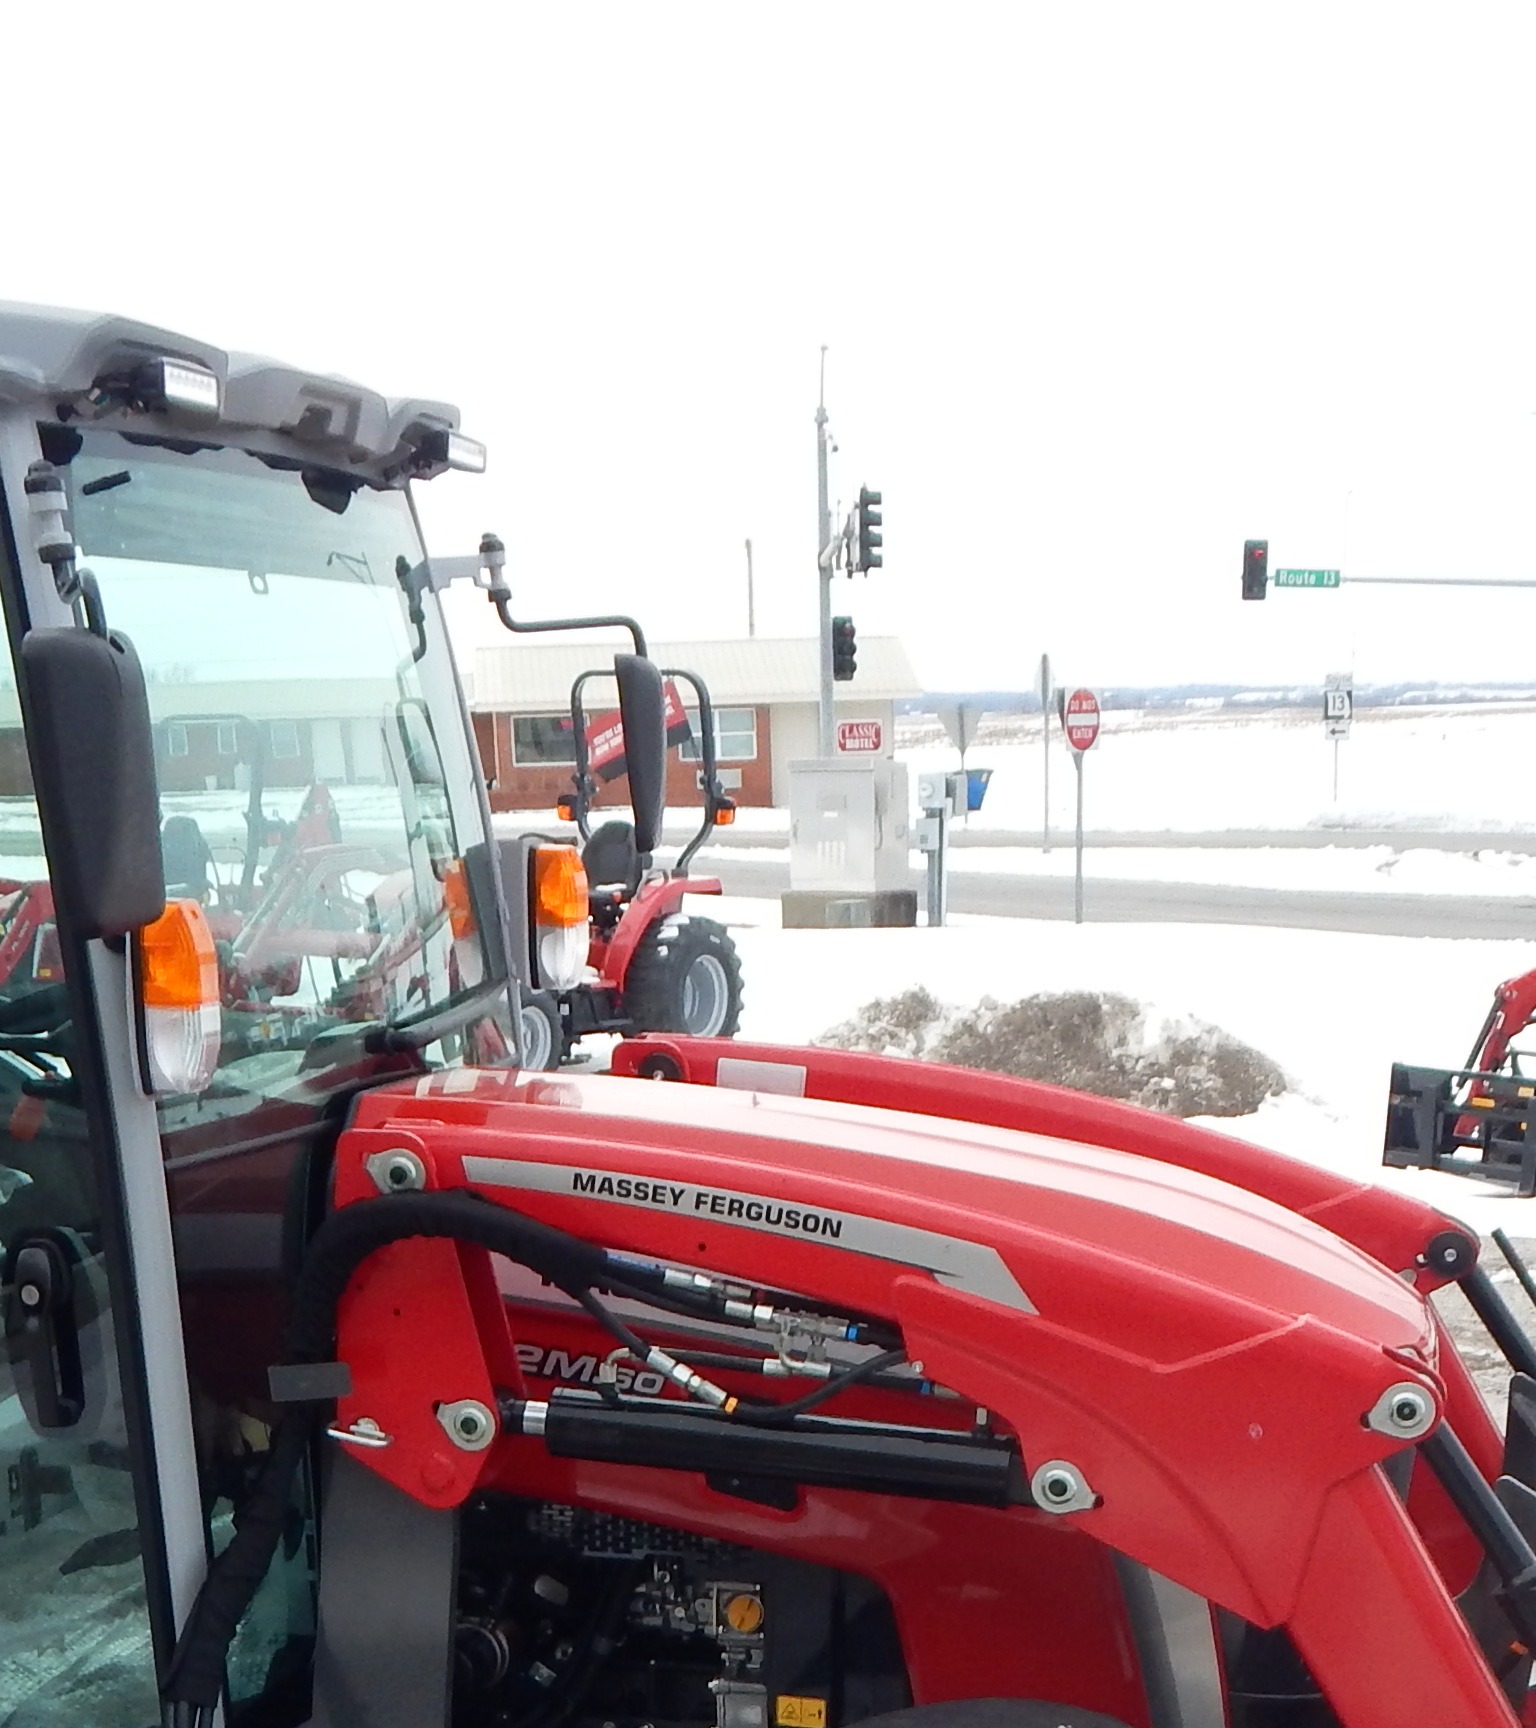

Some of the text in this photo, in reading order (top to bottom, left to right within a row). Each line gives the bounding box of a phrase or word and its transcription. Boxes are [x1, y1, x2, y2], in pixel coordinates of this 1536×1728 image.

[1279, 570, 1336, 585] Route 13
[1332, 694, 1346, 712] 13
[838, 724, 881, 743] CLASSIC
[845, 738, 874, 749] MOTEL
[571, 1171, 843, 1239] MASSEY FERGUSON
